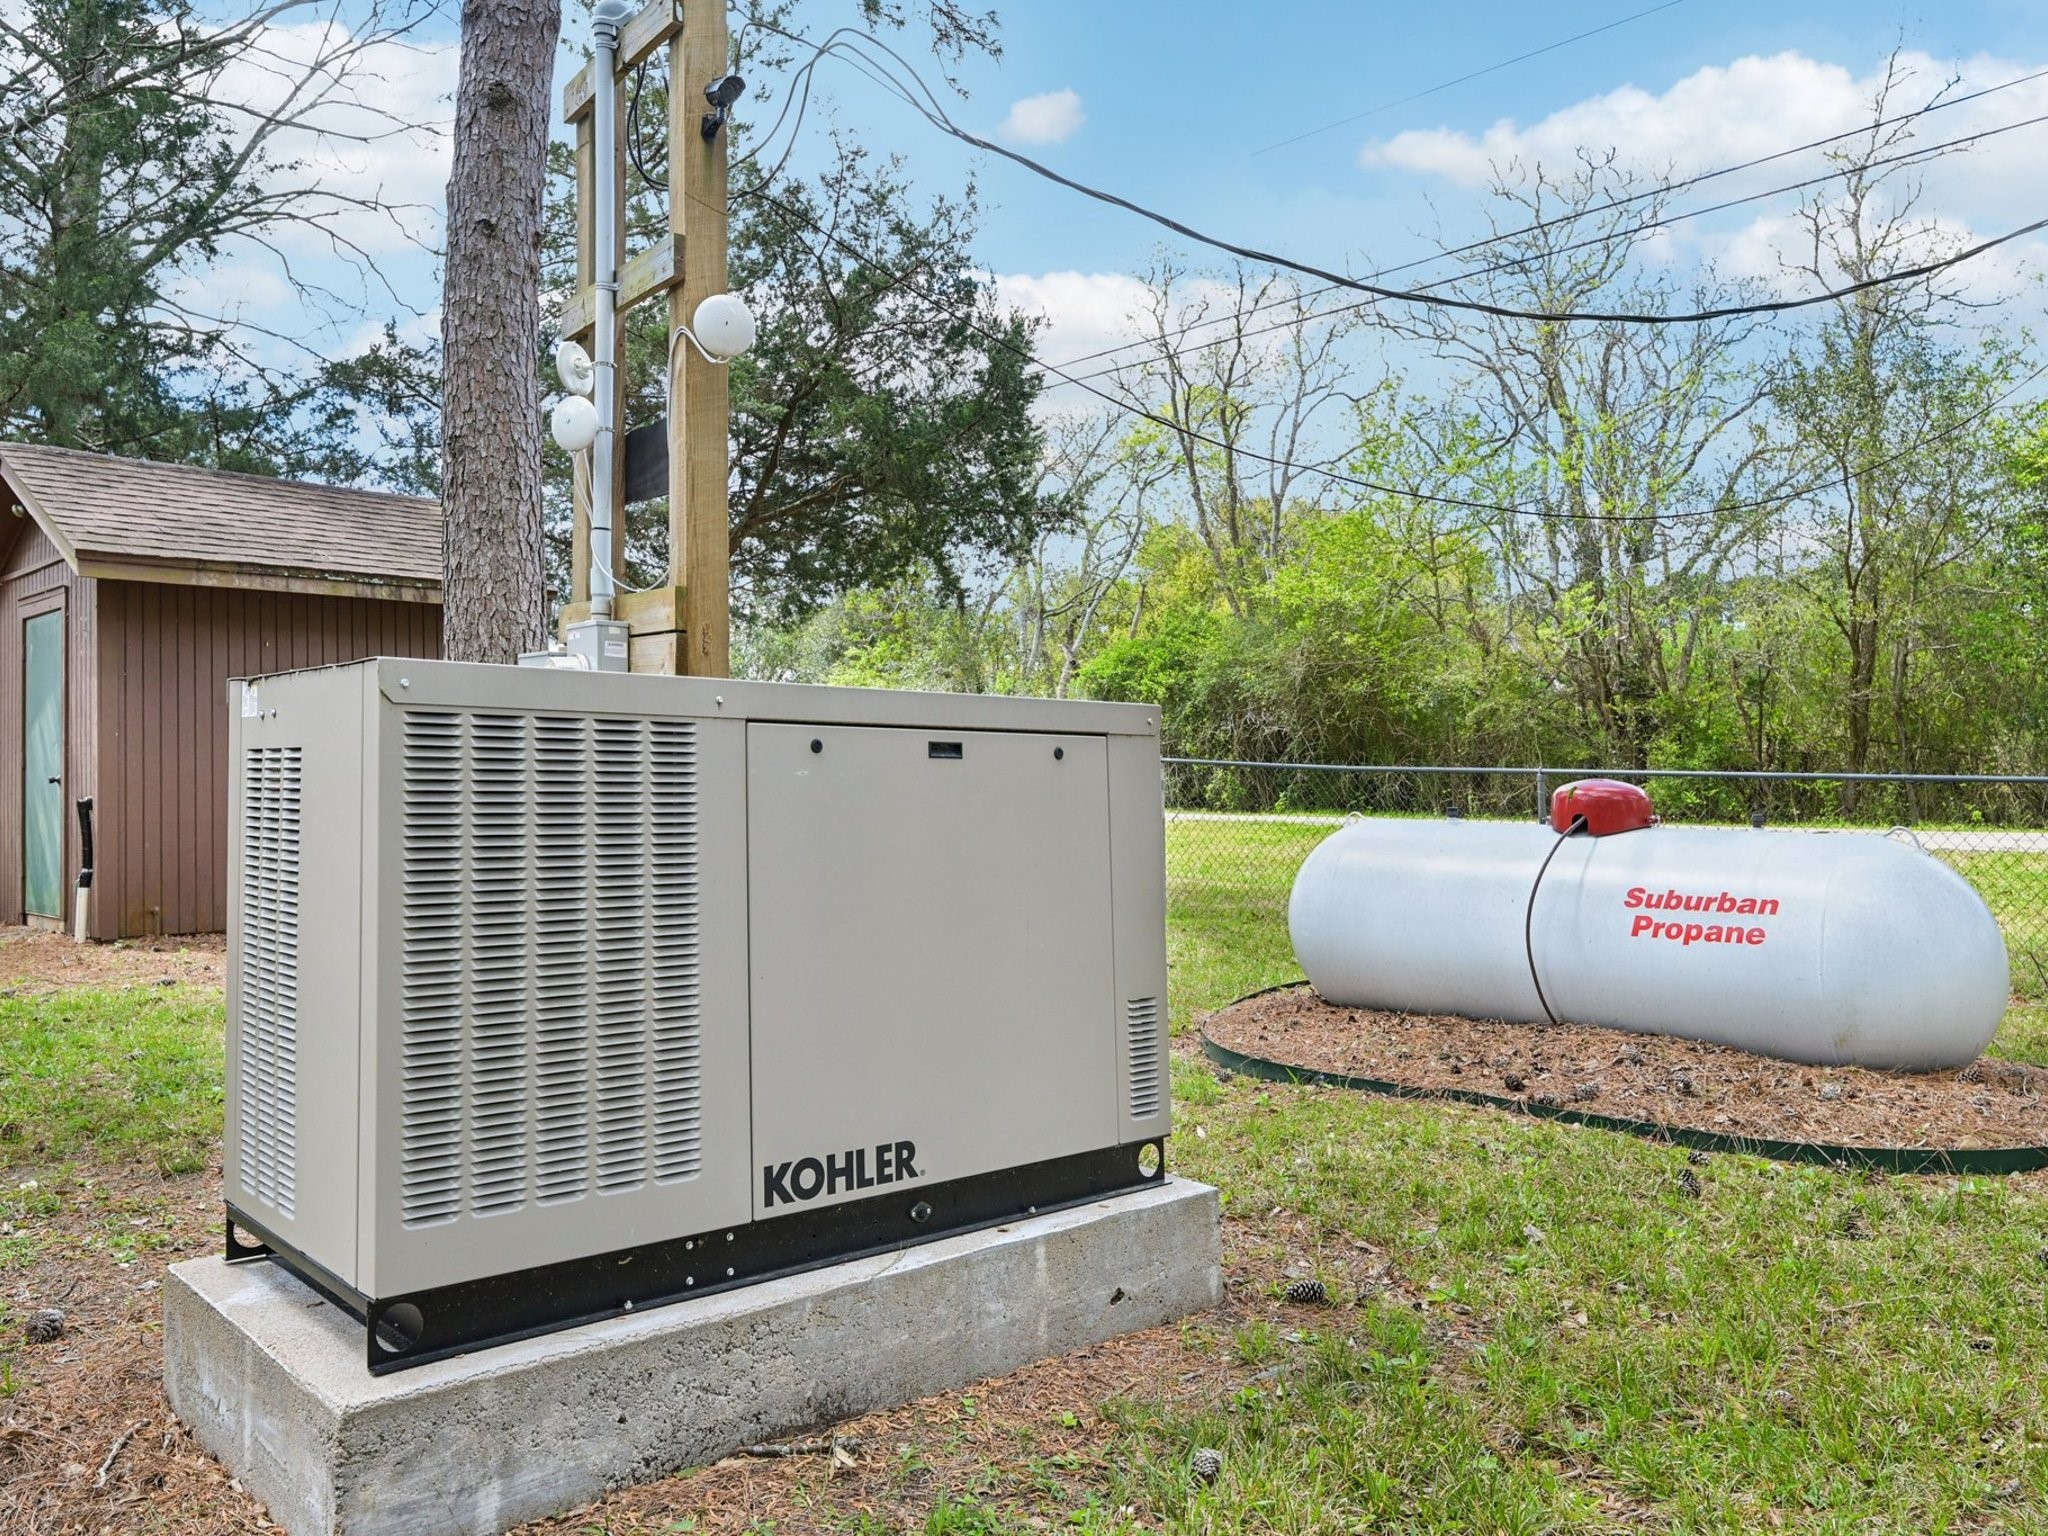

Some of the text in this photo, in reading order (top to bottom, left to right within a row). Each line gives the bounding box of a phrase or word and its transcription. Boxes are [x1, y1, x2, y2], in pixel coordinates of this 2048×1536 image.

[1624, 887, 1780, 916] Suburban
[1631, 915, 1766, 946] Propane
[763, 1140, 919, 1208] KOHLER
